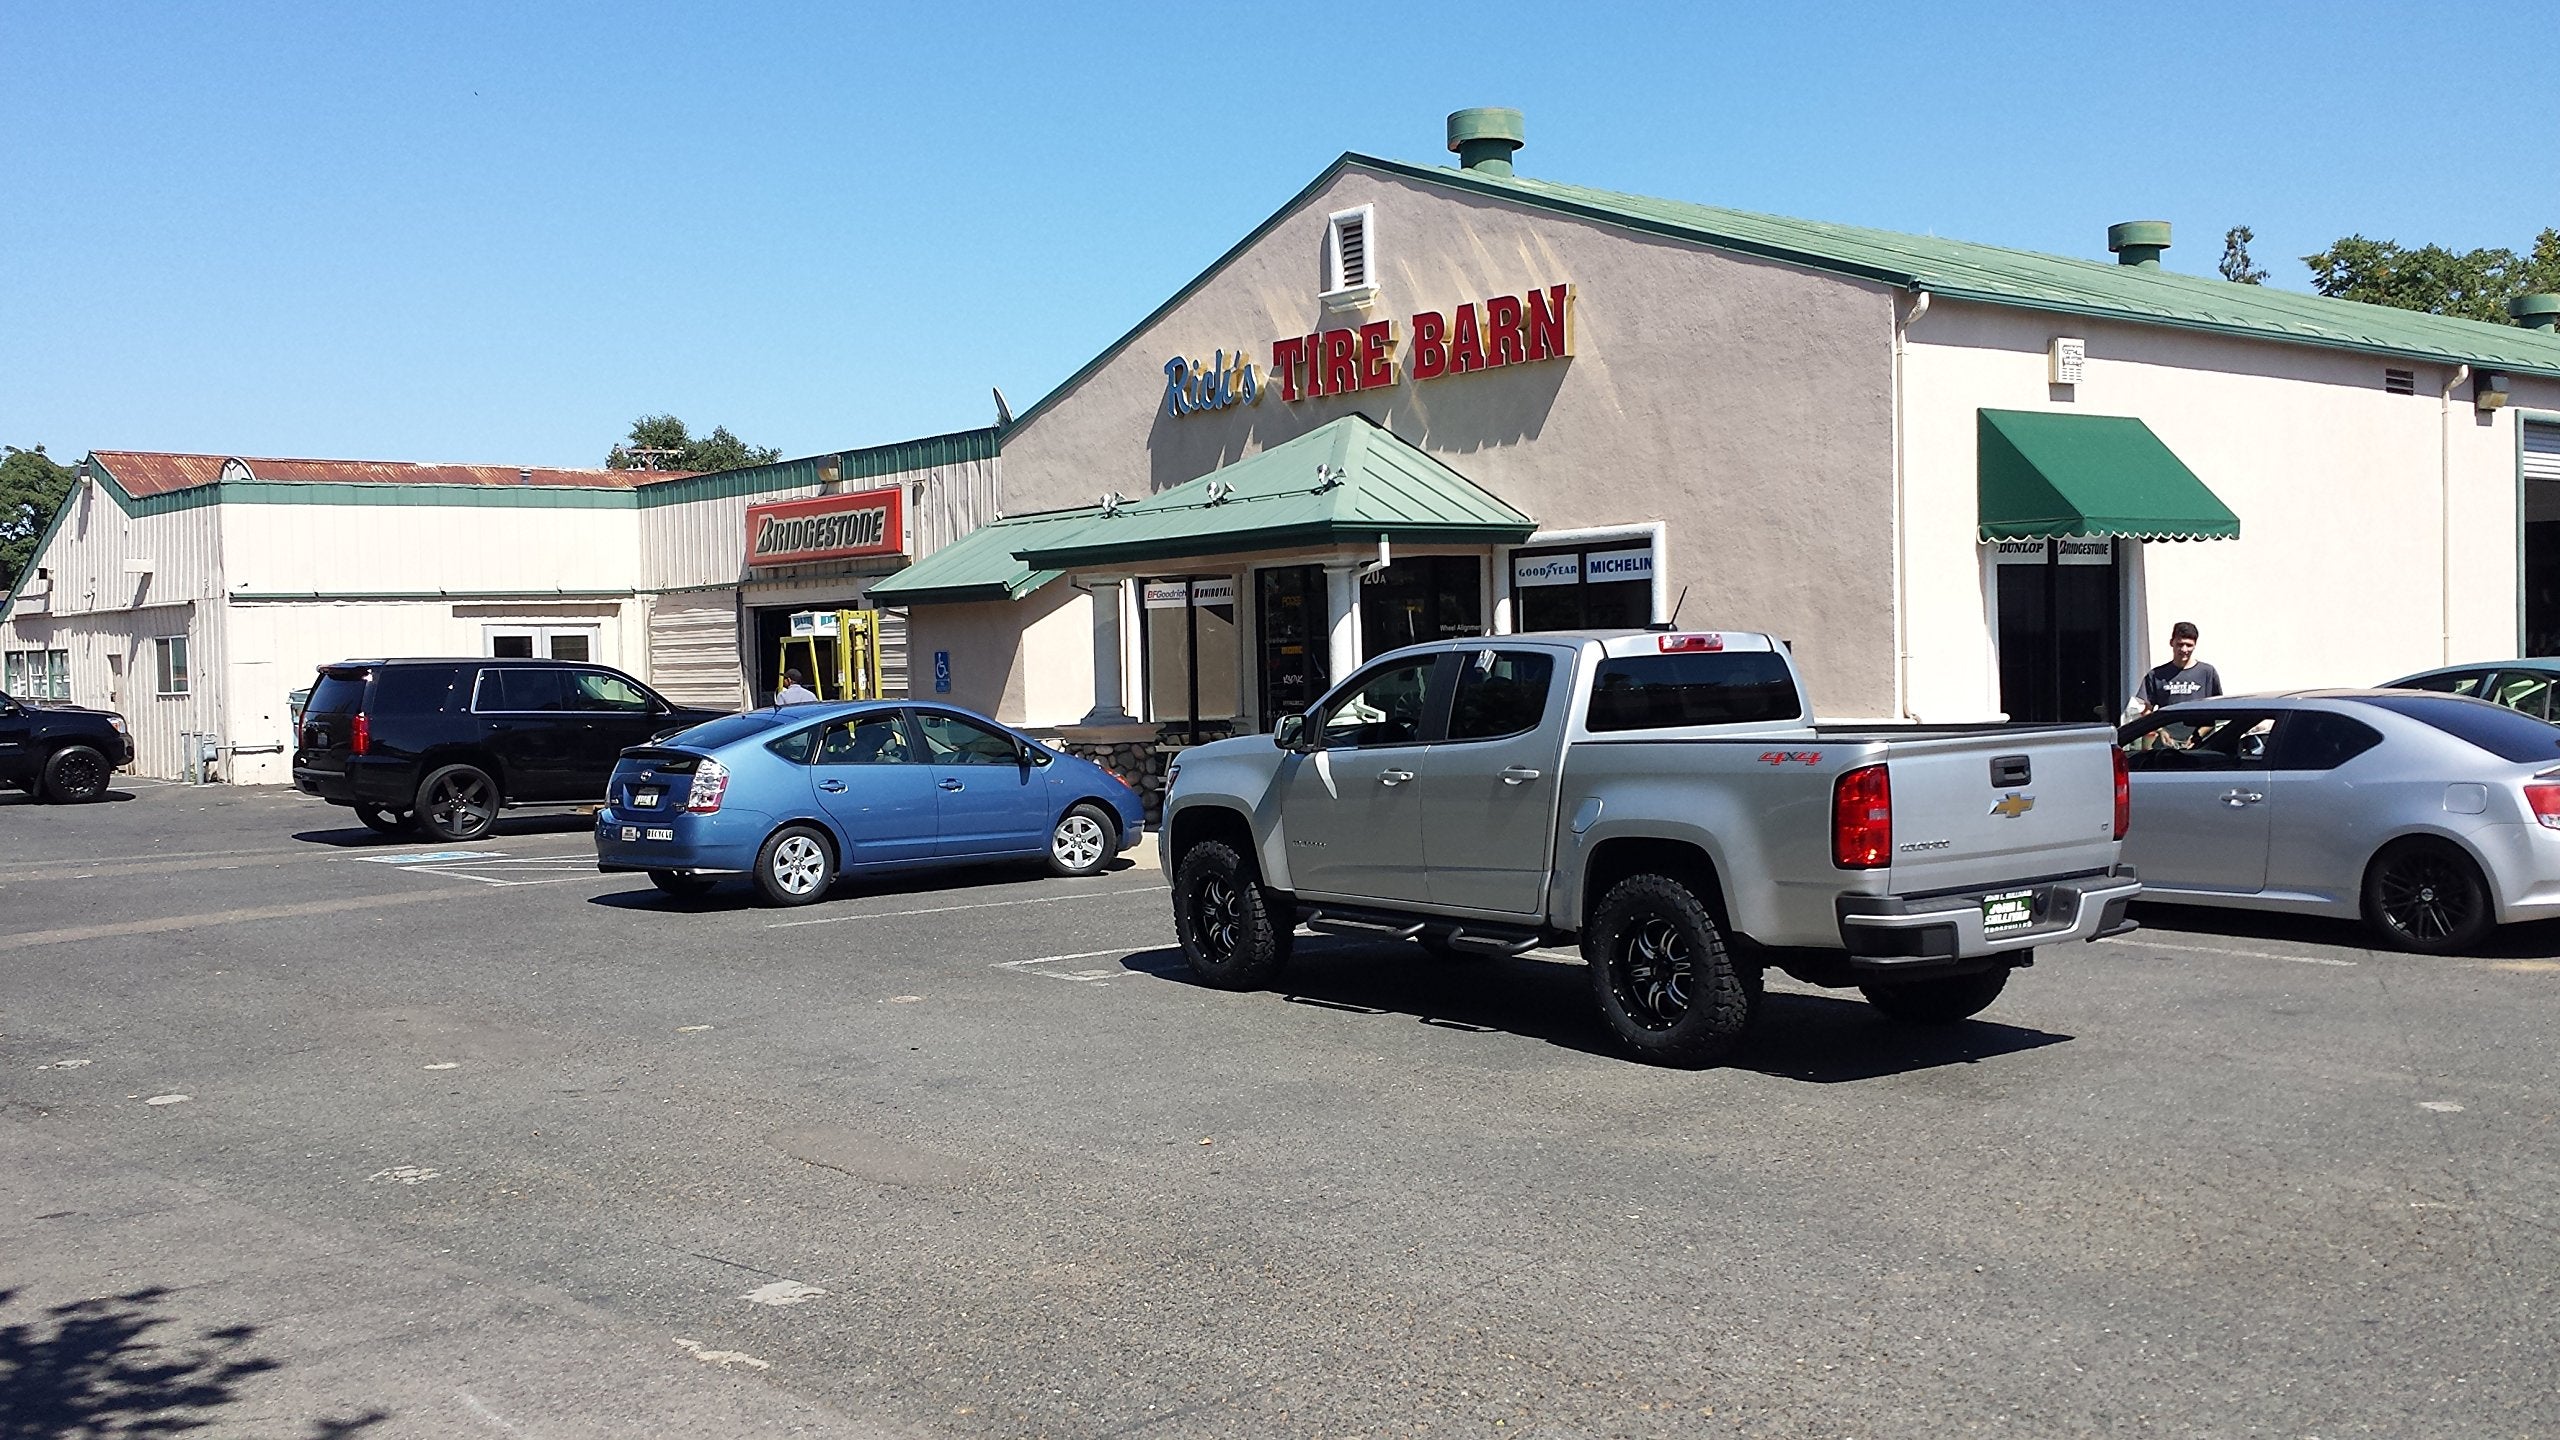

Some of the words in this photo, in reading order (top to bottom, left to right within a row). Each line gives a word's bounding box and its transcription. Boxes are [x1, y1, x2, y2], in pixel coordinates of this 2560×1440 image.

[1164, 349, 1257, 417] Rick's
[1273, 319, 1398, 401] TIRE
[1412, 284, 1573, 380] BARN
[756, 510, 885, 555] BRIDGESTONE
[1998, 542, 2044, 553] DUNLOP
[2059, 540, 2109, 554] BRIDGESTONE
[1590, 557, 1652, 574] MICHELIN
[1147, 589, 1187, 599] BFGoodrich
[1440, 624, 1457, 632] Wheel
[647, 830, 673, 839] RECYCLE
